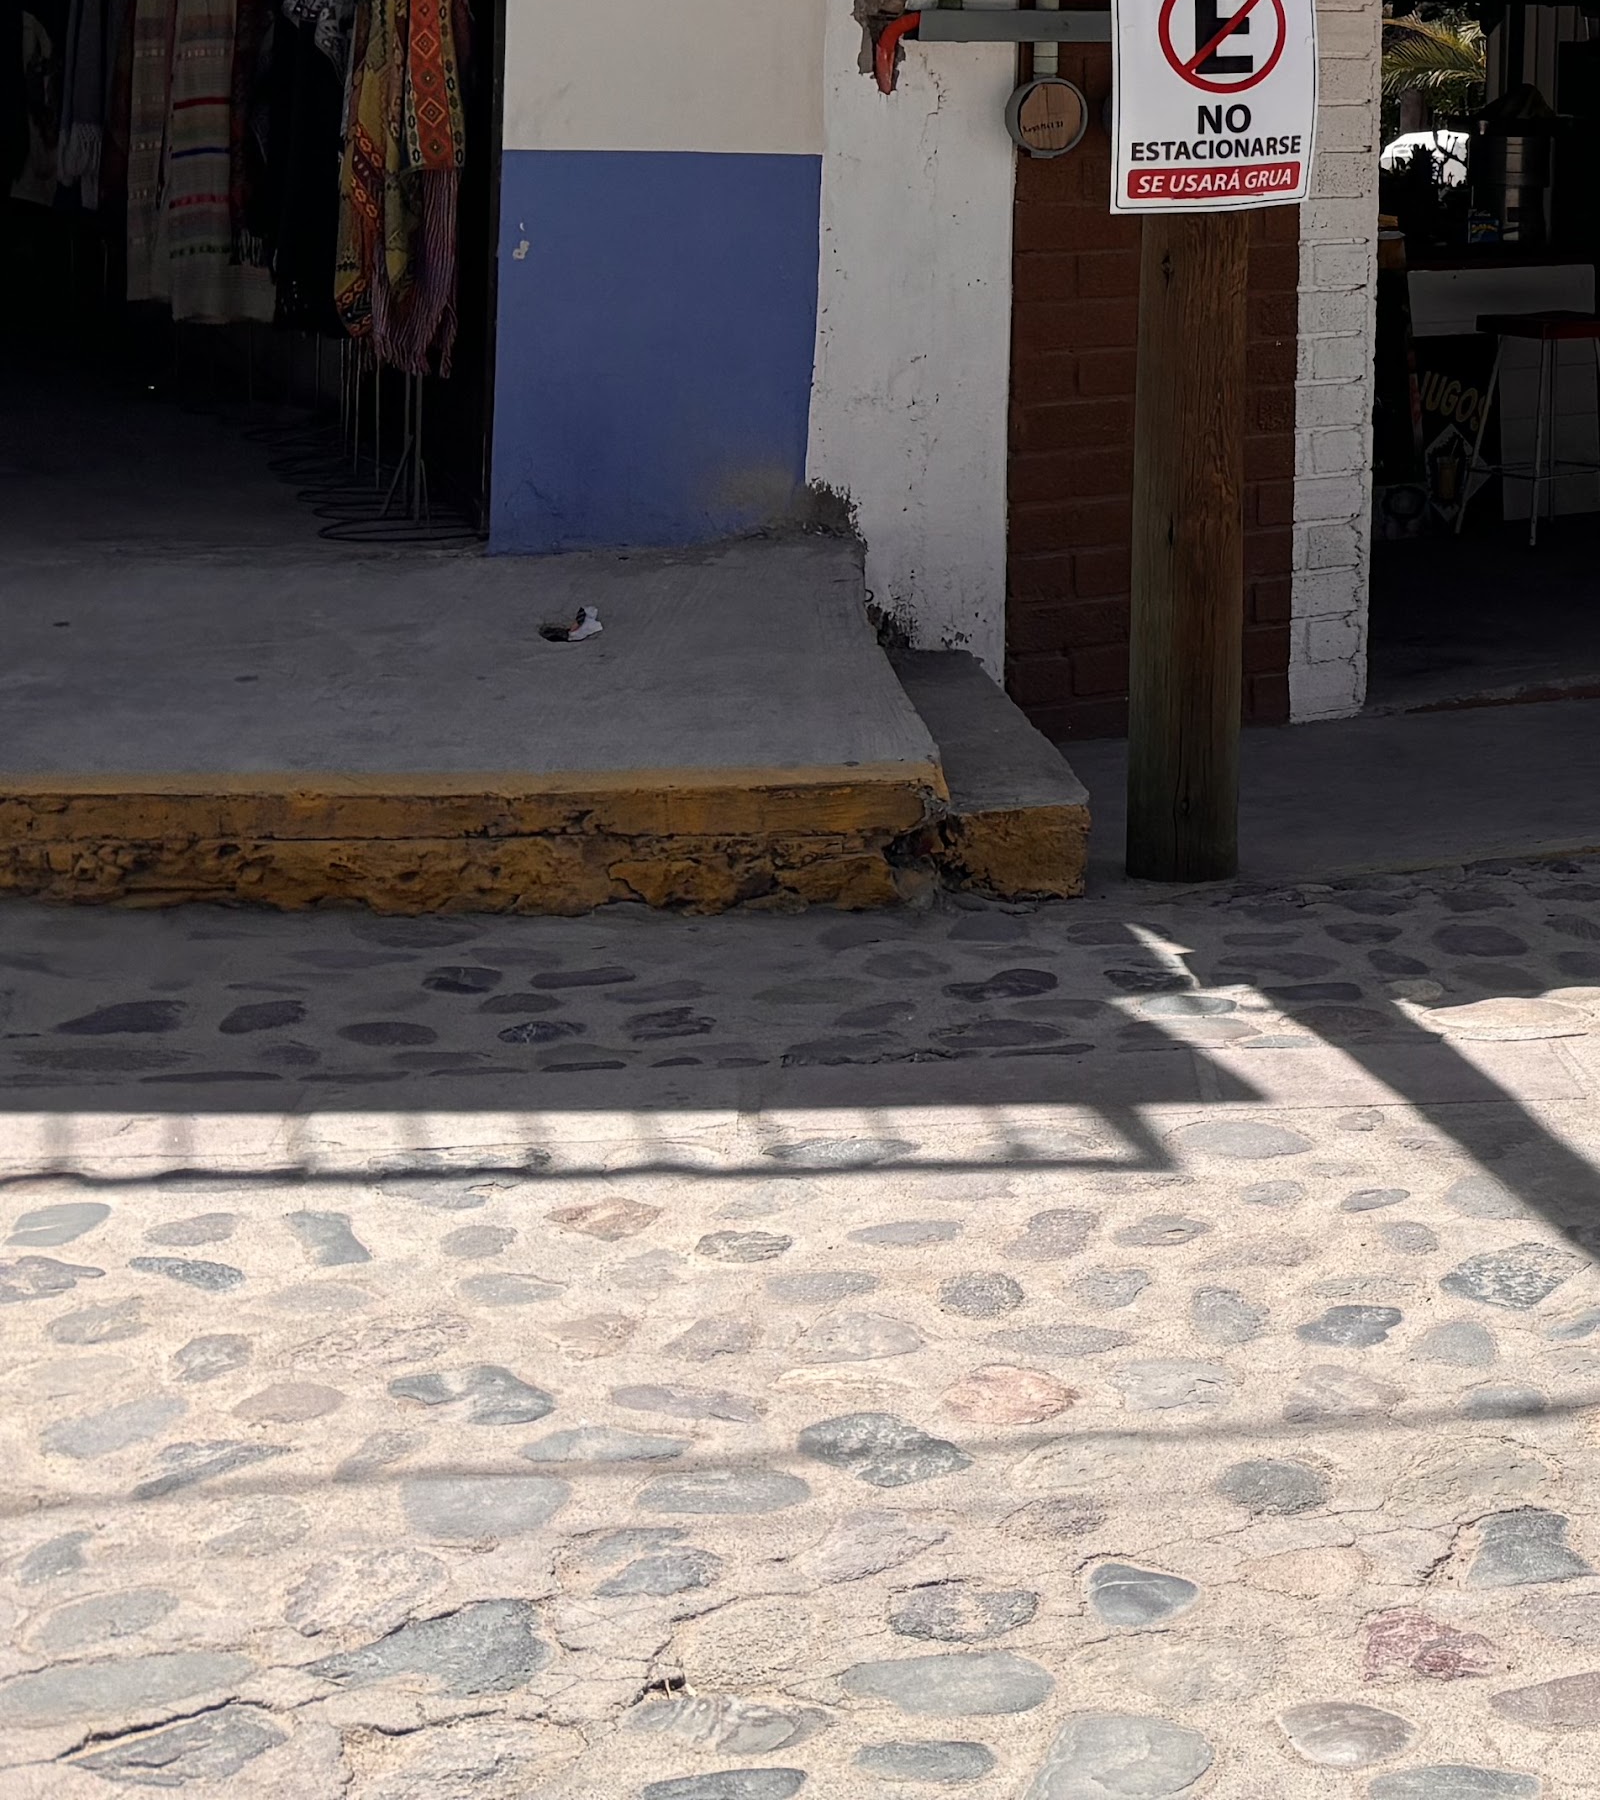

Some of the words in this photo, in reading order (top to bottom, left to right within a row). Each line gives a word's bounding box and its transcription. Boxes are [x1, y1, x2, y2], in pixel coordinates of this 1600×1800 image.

[1197, 103, 1252, 135] NO
[1131, 135, 1301, 162] ESTACIONARSE
[1137, 176, 1165, 193] SE
[1169, 171, 1240, 192] USARÁ
[1244, 168, 1292, 188] GRUA
